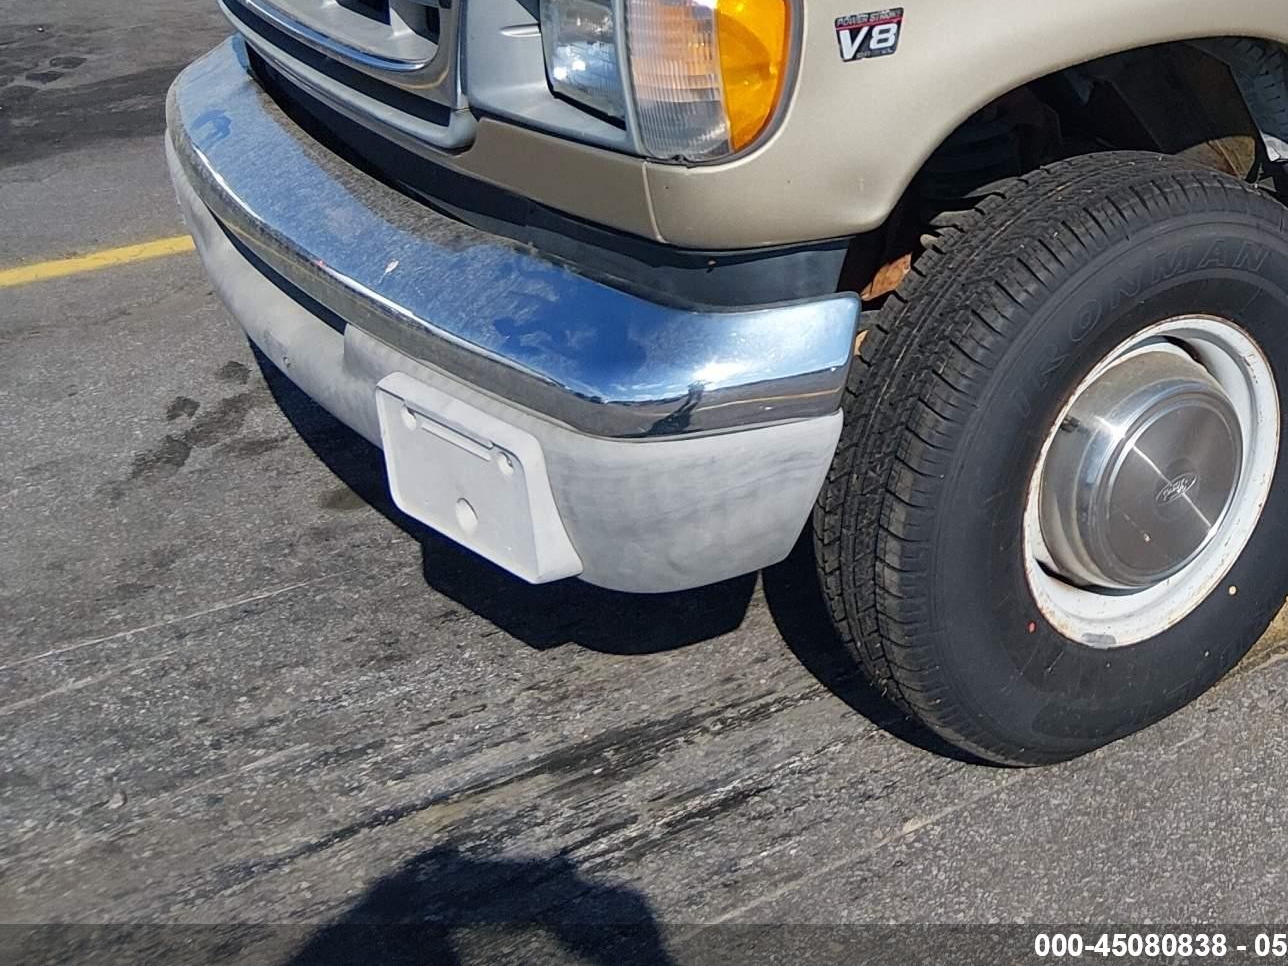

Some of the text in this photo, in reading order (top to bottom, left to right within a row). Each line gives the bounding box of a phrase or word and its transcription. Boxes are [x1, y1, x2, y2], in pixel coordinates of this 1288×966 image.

[837, 13, 868, 27] POWER
[839, 23, 898, 60] V8
[1020, 239, 1273, 416] IRONMAN
